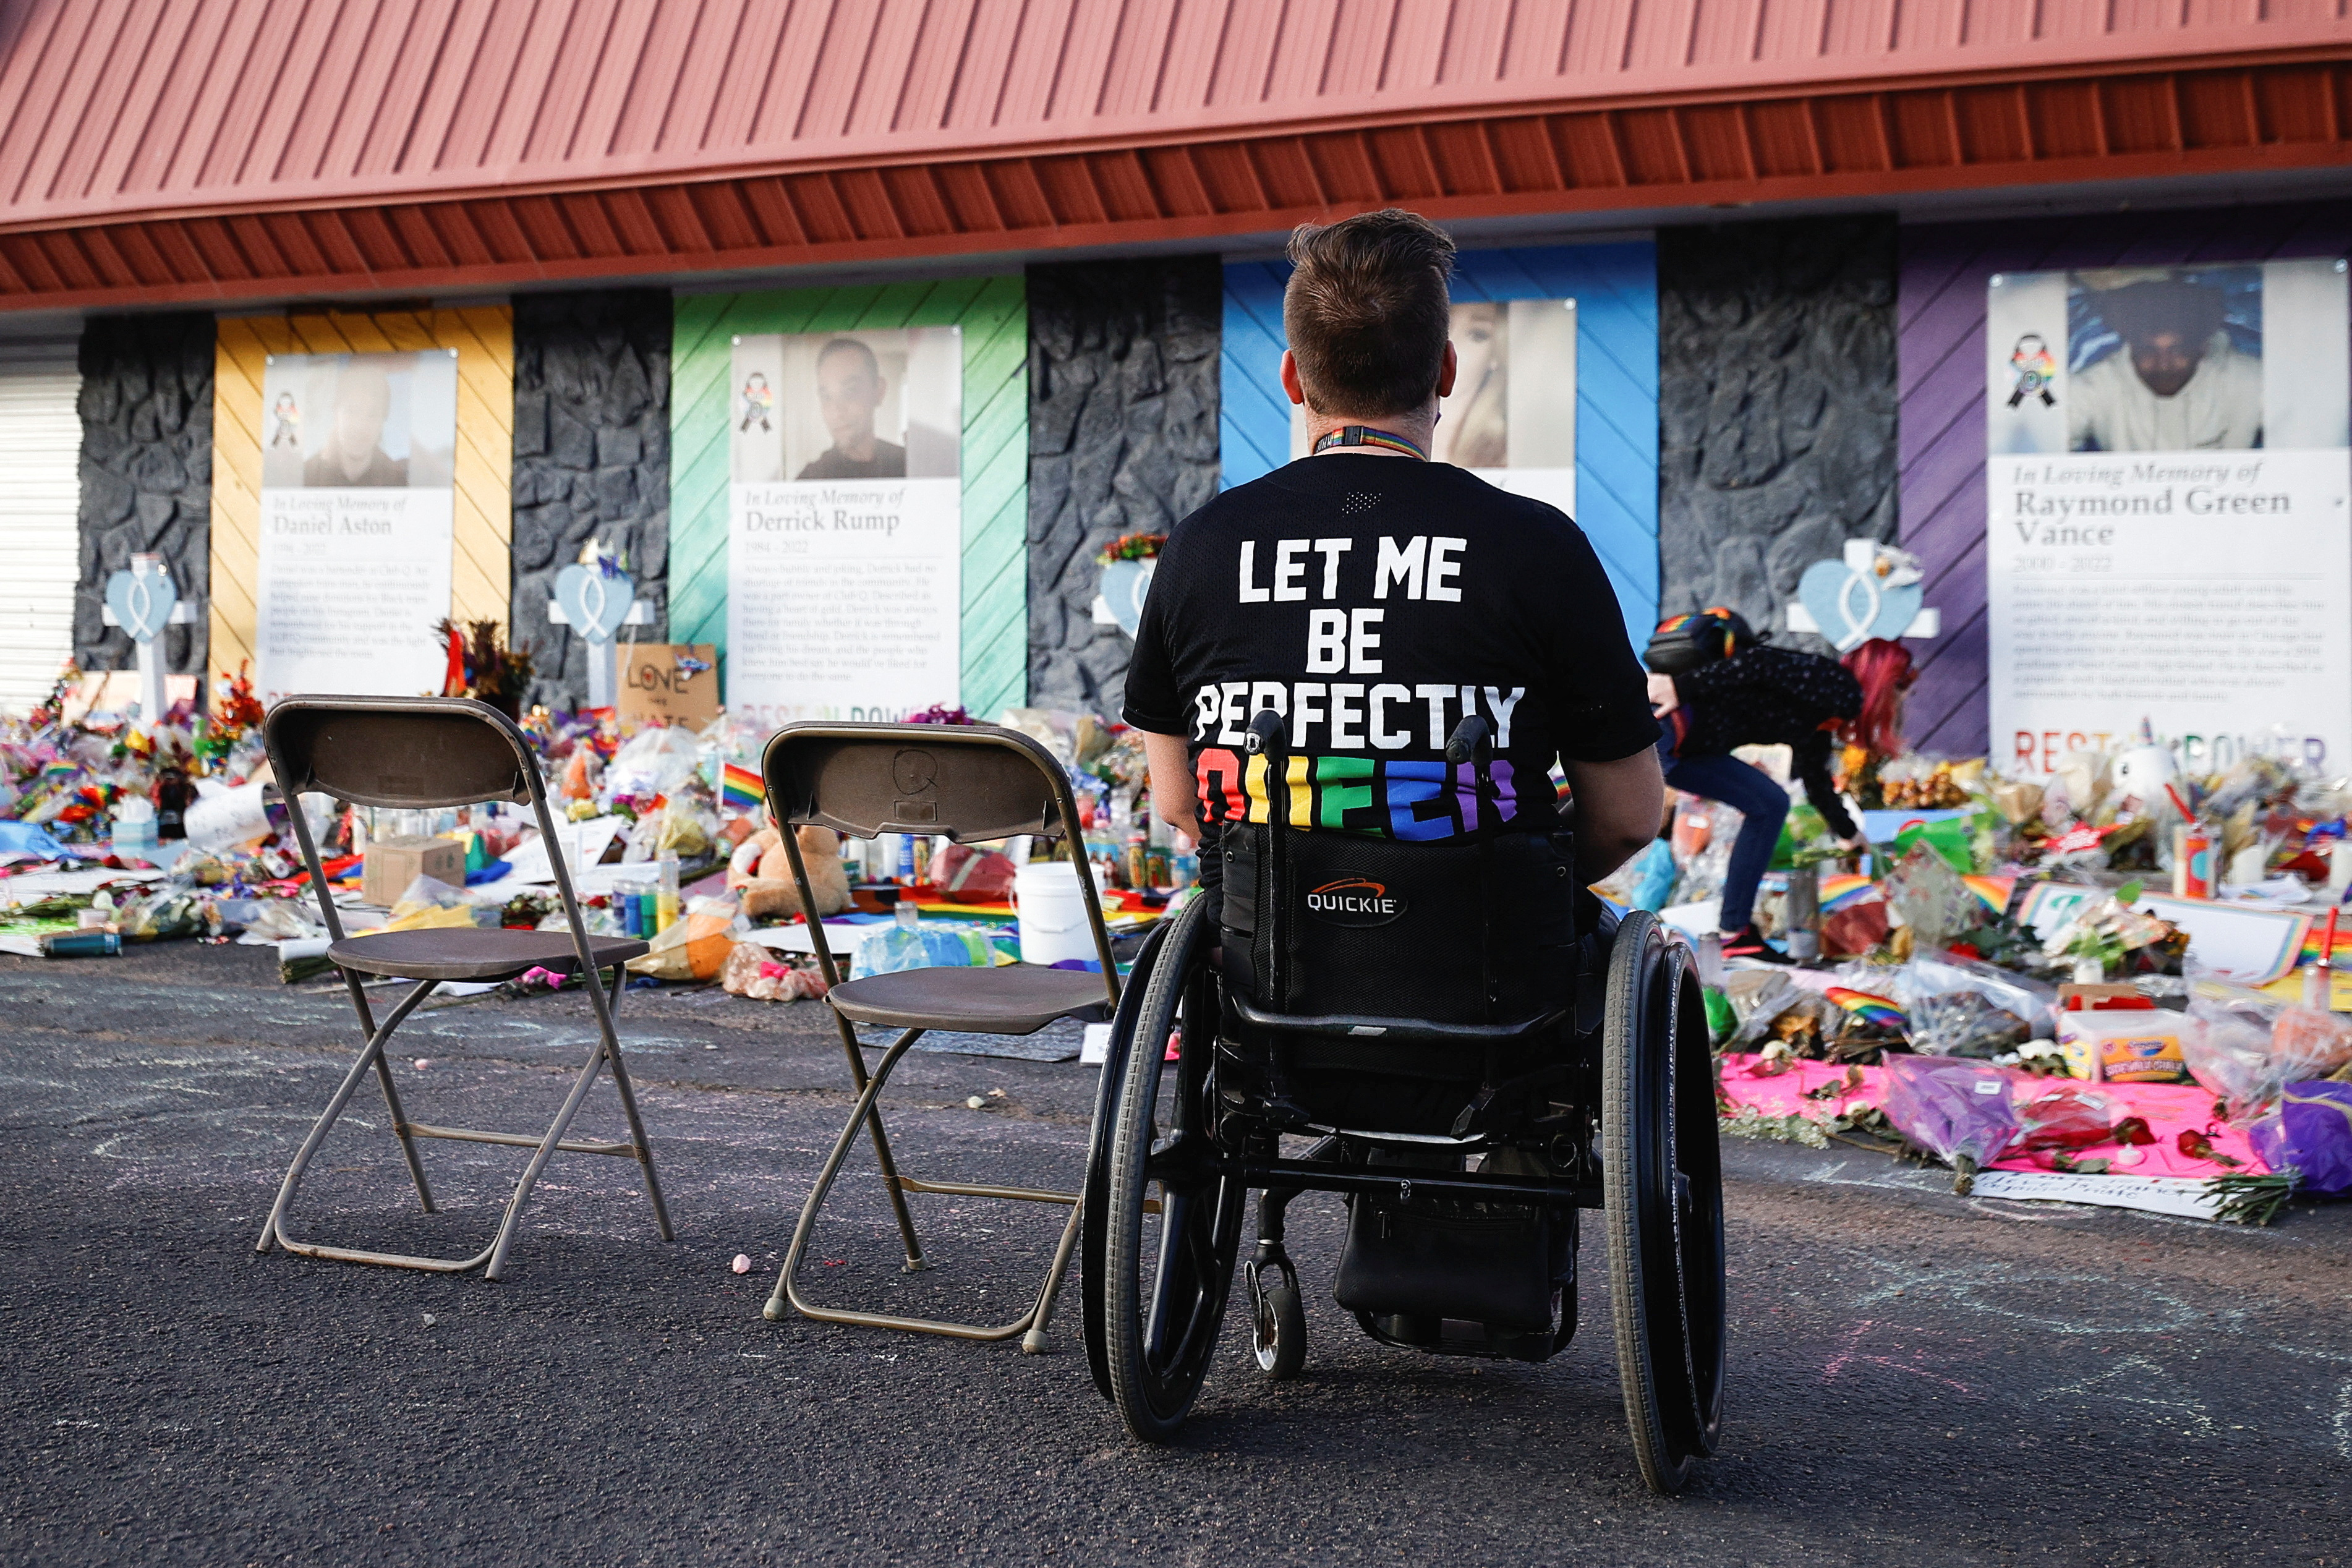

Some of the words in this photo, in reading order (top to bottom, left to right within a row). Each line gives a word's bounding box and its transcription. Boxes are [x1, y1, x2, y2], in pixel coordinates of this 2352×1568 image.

[2013, 466, 2036, 485] In
[2044, 464, 2124, 488] Loving
[2132, 462, 2230, 488] Memory
[2237, 460, 2264, 487] of
[290, 496, 333, 513] Loving
[338, 495, 388, 512] Memory
[744, 490, 760, 506] In
[765, 490, 816, 509] Loving
[820, 488, 884, 508] Memory
[888, 487, 906, 508] of
[2015, 487, 2172, 524] Raymond
[2185, 485, 2291, 514] Green
[273, 510, 332, 535] Daniel
[339, 515, 392, 535] Aston
[746, 508, 827, 532] Derrick
[833, 509, 901, 537] Rump
[2014, 518, 2115, 546] Vance
[782, 540, 809, 553] 2022
[1238, 537, 1353, 603] LET
[1373, 535, 1467, 602] ME
[1306, 608, 1385, 675] BE
[628, 664, 689, 694] LOVE
[1194, 681, 1525, 750] PERFECTLY
[2185, 735, 2328, 777] POR
[892, 748, 939, 796] Q
[1307, 893, 1395, 914] QUICKIE
